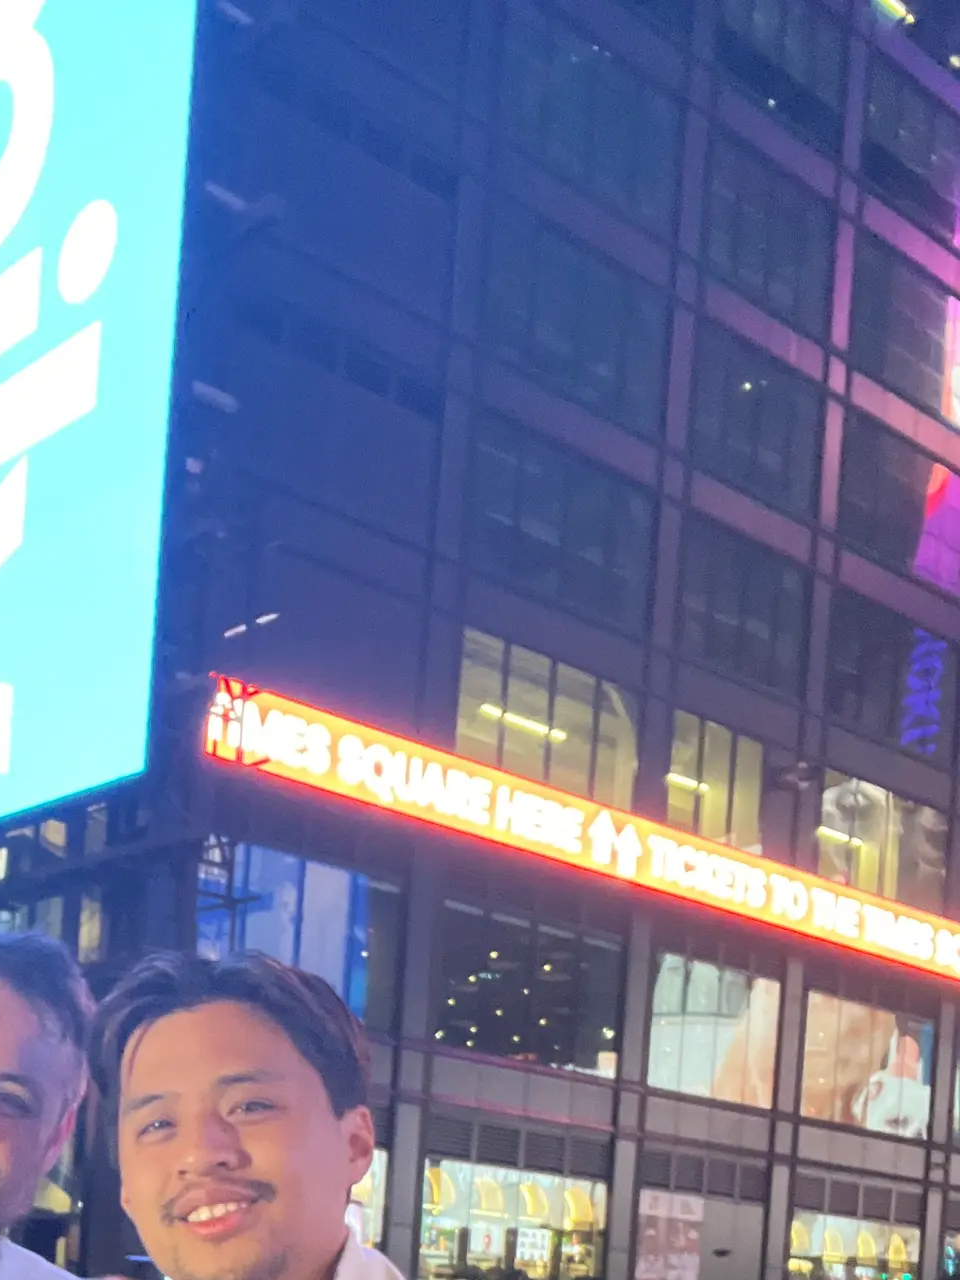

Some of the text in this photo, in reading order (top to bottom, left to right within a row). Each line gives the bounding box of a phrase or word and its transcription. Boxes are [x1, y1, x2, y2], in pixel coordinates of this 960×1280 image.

[336, 734, 492, 826] SQUARE
[494, 785, 585, 854] HERE
[647, 834, 767, 909] TICKETS
[769, 873, 809, 921] TO
[810, 887, 861, 938] THE
[860, 903, 935, 961] TIMES
